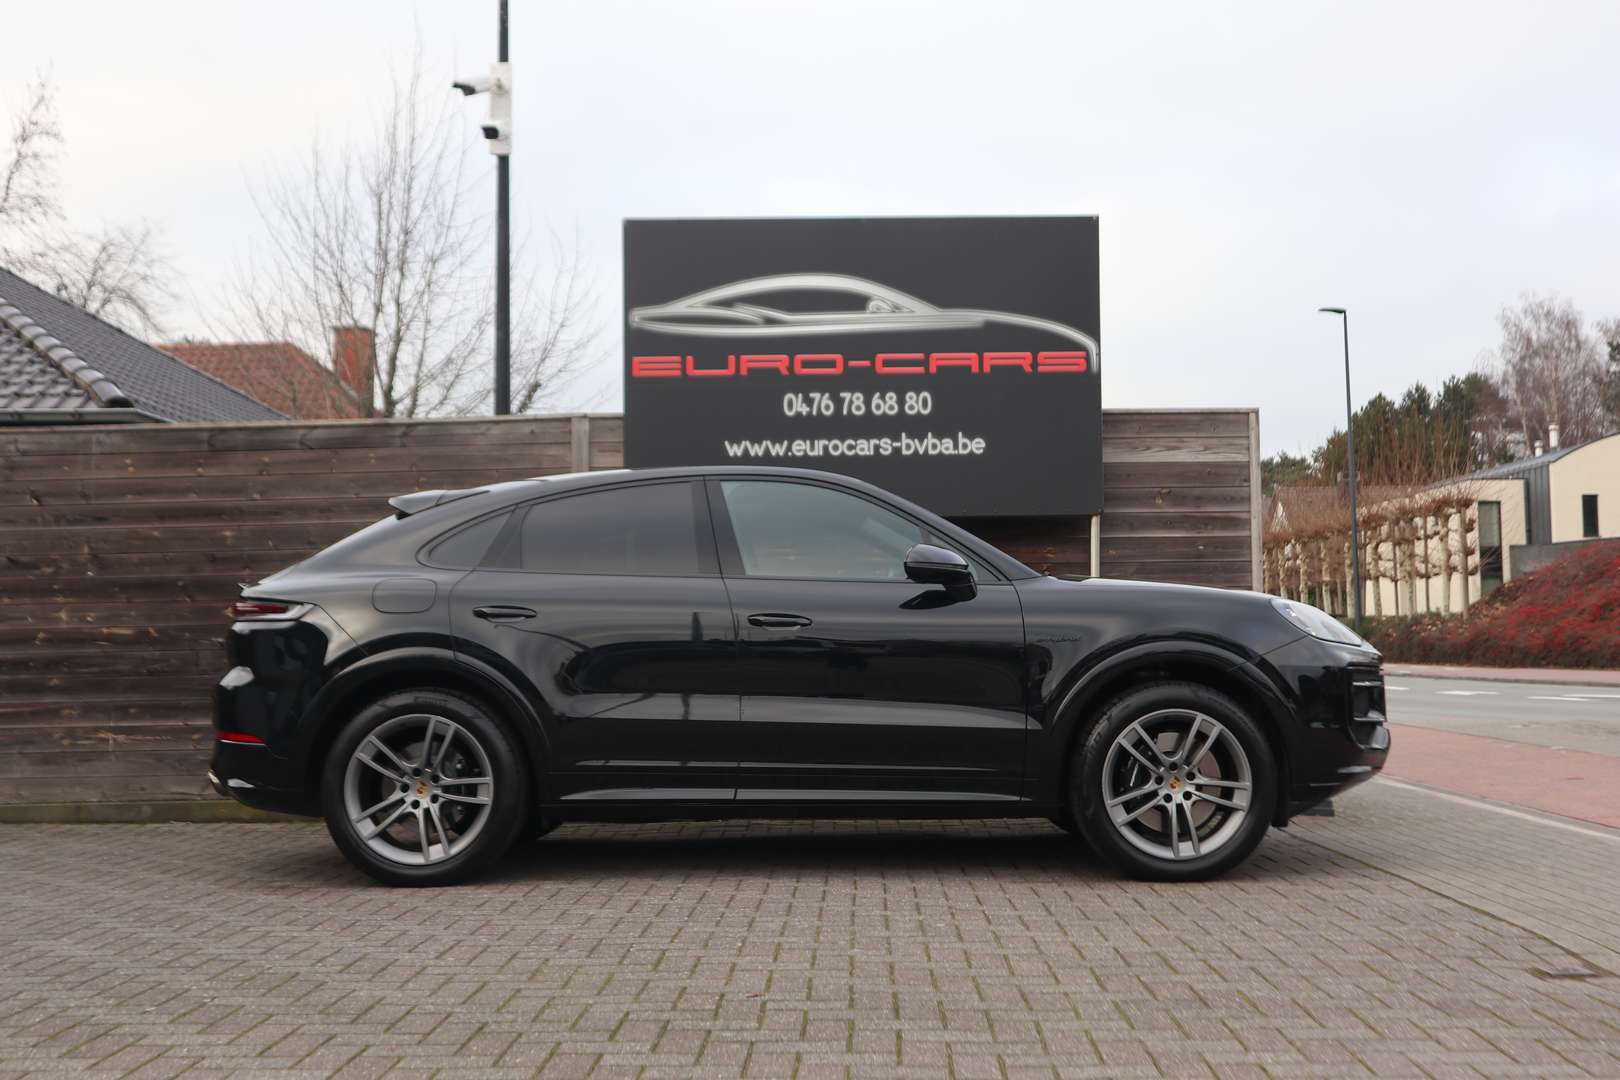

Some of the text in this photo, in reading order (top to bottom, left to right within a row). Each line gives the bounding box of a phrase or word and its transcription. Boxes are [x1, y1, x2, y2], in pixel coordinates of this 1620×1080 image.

[631, 351, 1088, 377] EURO-CARS
[783, 391, 932, 416] 0476 78 68 80
[725, 433, 986, 457] www.eurocars-bvba.be
